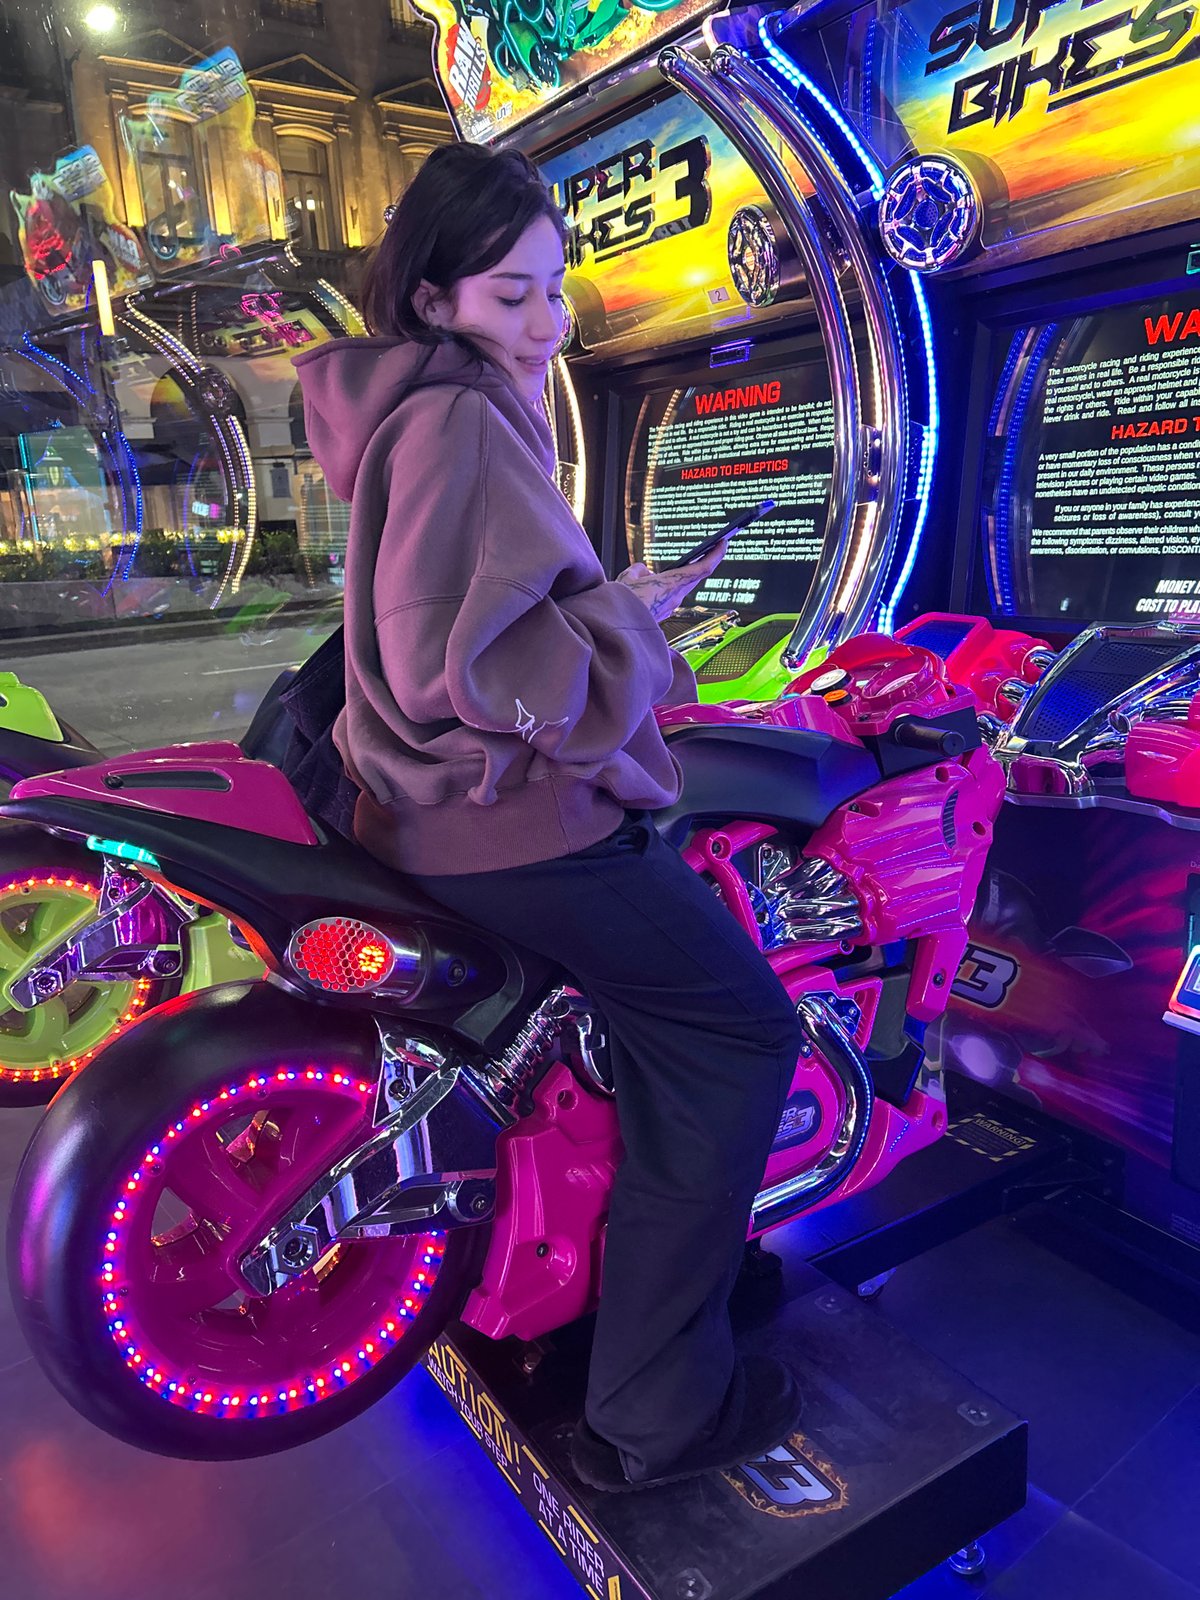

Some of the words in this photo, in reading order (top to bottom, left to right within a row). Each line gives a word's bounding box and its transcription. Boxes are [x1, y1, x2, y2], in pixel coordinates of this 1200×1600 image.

[449, 17, 475, 100] RAW
[947, 0, 1200, 135] BIKES
[659, 134, 712, 230] 3
[1145, 309, 1200, 345] WA
[1063, 362, 1097, 373] motorcycle
[1100, 359, 1120, 367] racing
[1123, 355, 1137, 364] and
[1139, 353, 1159, 362] riding
[1097, 369, 1110, 378] real
[1148, 358, 1189, 371] responsible
[1054, 383, 1079, 395] yourself
[1080, 381, 1092, 390] and
[1129, 376, 1135, 384] A
[1136, 373, 1150, 383] real
[1152, 368, 1191, 380] motorcycle
[1124, 382, 1156, 395] approved
[1157, 380, 1182, 390] helmet
[1183, 377, 1198, 386] and
[695, 381, 781, 414] WARNING
[1044, 406, 1054, 414] the
[1076, 402, 1083, 410] of
[1114, 397, 1130, 405] Ride
[1133, 394, 1153, 403] within
[1156, 392, 1173, 402] your
[1043, 415, 1062, 423] Never
[1064, 412, 1080, 421] drink
[1081, 410, 1095, 419] and
[1097, 409, 1111, 417] ride.
[1117, 405, 1136, 414] Read
[1139, 403, 1152, 412] and
[1155, 402, 1177, 410] follow
[1179, 399, 1188, 407] all
[1111, 418, 1187, 439] HAZARD
[1039, 453, 1044, 461] A
[1045, 453, 1058, 461] very
[1059, 451, 1076, 459] small
[1076, 449, 1099, 459] portion
[1100, 447, 1107, 455] of
[1108, 447, 1119, 455] the
[1120, 444, 1156, 455] population
[1157, 443, 1170, 451] has
[1062, 460, 1097, 468] momentary
[1113, 456, 1120, 464] of
[1121, 454, 1172, 464] consciousness
[1173, 451, 1193, 459] when
[681, 465, 718, 480] HAZARD
[720, 464, 732, 477] TO
[733, 459, 789, 475] EPILEPTICS
[1061, 470, 1066, 478] in
[1079, 468, 1095, 477] daily
[1142, 464, 1164, 472] These
[1165, 462, 1195, 472] persons
[1099, 476, 1123, 485] playing
[1124, 474, 1148, 483] certain
[1170, 472, 1196, 482] games.
[1072, 488, 1088, 496] have
[1099, 485, 1136, 494] undetected
[1137, 483, 1167, 494] epileptic
[1060, 505, 1072, 514] you
[1080, 505, 1104, 513] anyone
[1112, 503, 1128, 512] your
[1128, 501, 1149, 510] family
[1150, 500, 1163, 508] has
[1092, 513, 1106, 521] loss
[1108, 512, 1116, 520] of
[1164, 509, 1192, 518] consult
[1116, 526, 1143, 534] observe
[1144, 526, 1159, 534] their
[1160, 525, 1188, 533] children
[1166, 535, 1189, 544] vision,
[1155, 580, 1196, 594] MONEY
[1136, 598, 1165, 612] COST
[1163, 599, 1179, 612] TO
[1178, 599, 1200, 613] PLA
[428, 1341, 521, 1475] AUTION!
[428, 1354, 458, 1403] WATCH
[459, 1395, 484, 1438] YOUR
[484, 1431, 508, 1468] STEP
[533, 1472, 560, 1519] ONE
[563, 1510, 604, 1577] RIDER
[539, 1499, 553, 1527] AT
[558, 1525, 567, 1547] A
[569, 1537, 604, 1596] TIME
